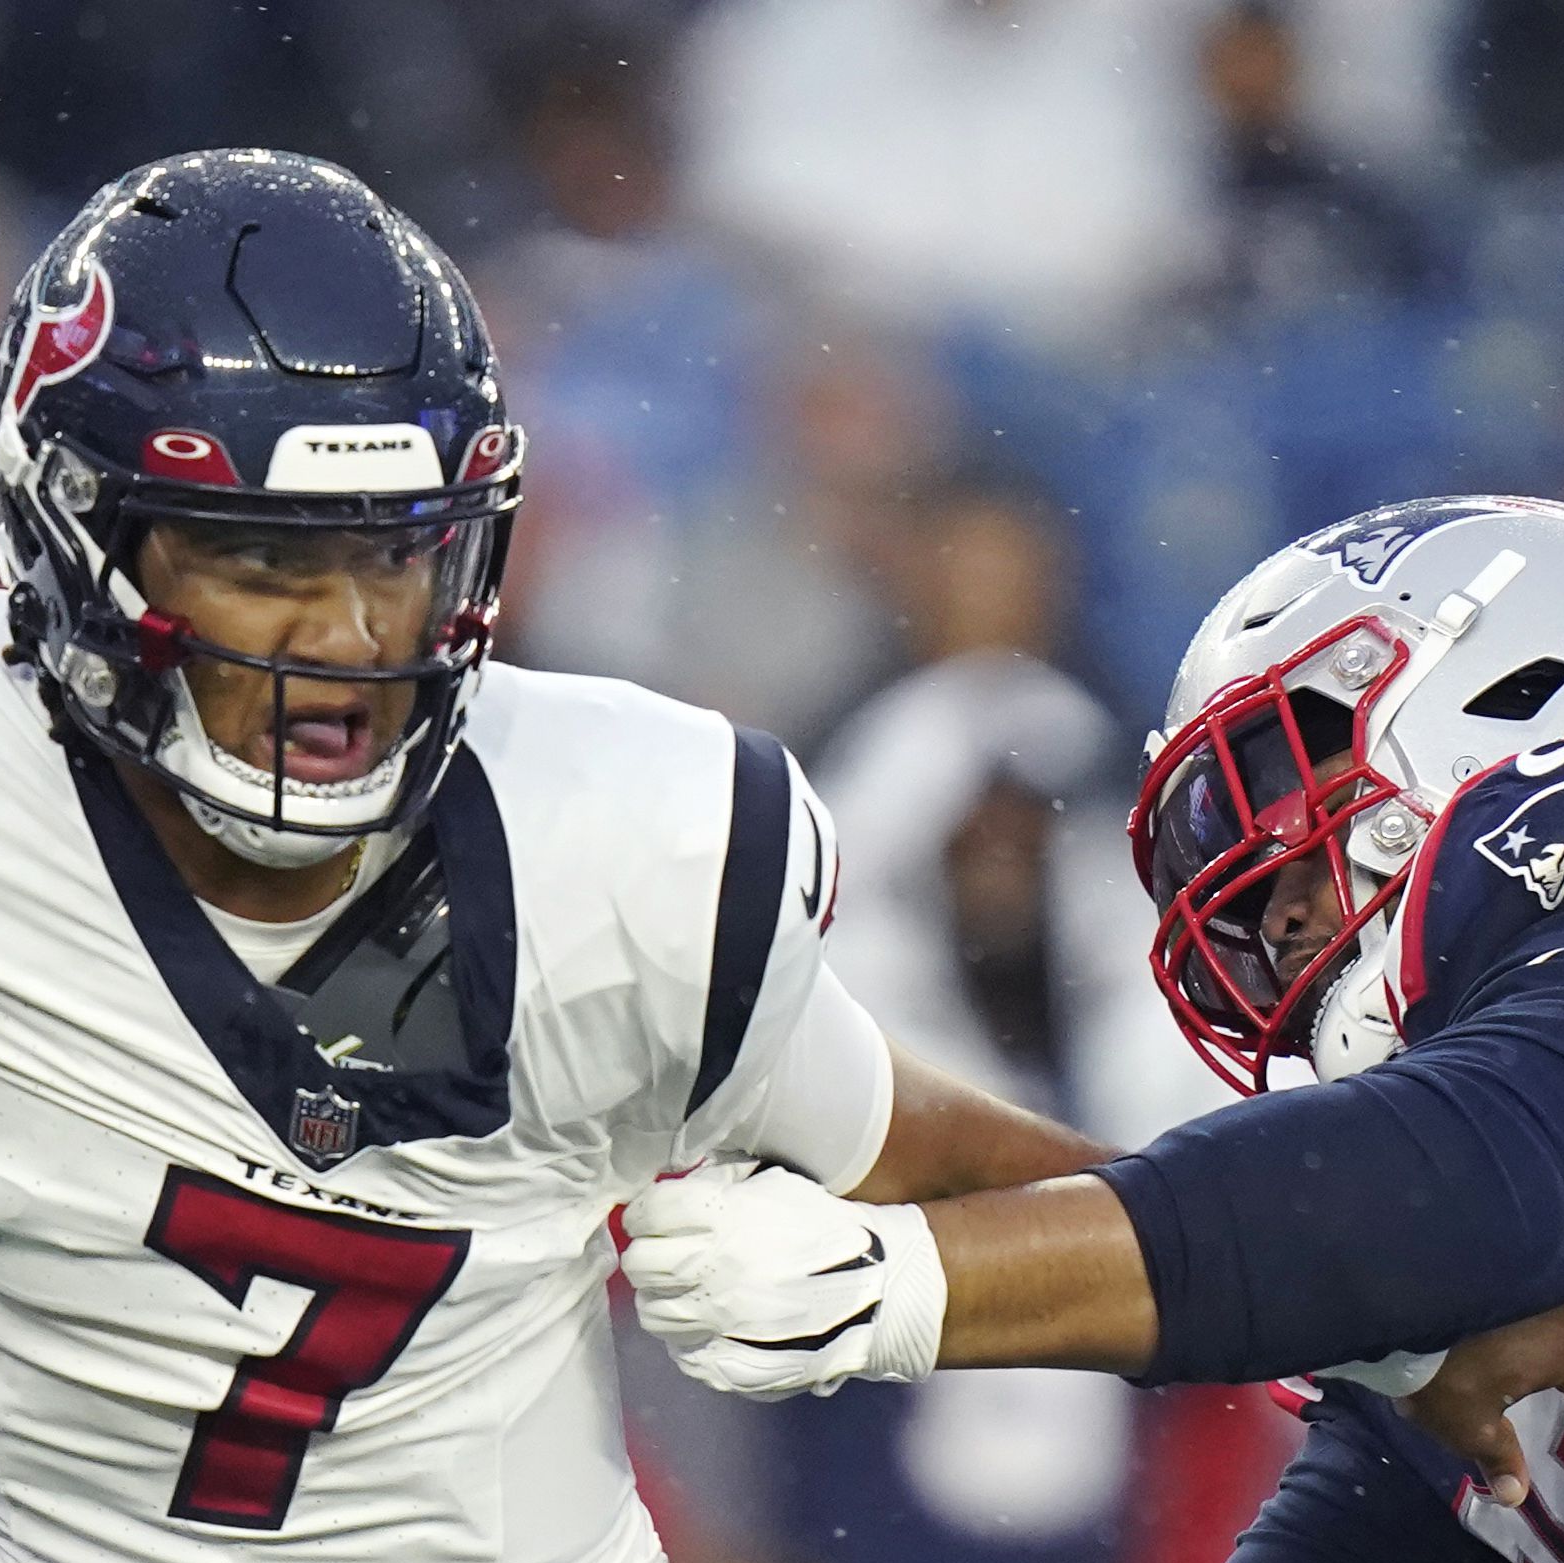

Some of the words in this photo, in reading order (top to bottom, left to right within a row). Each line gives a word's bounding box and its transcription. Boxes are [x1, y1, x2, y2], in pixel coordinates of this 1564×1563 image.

[304, 440, 413, 453] TEXANS
[301, 1119, 349, 1150] NFL
[143, 1163, 473, 1531] 7
